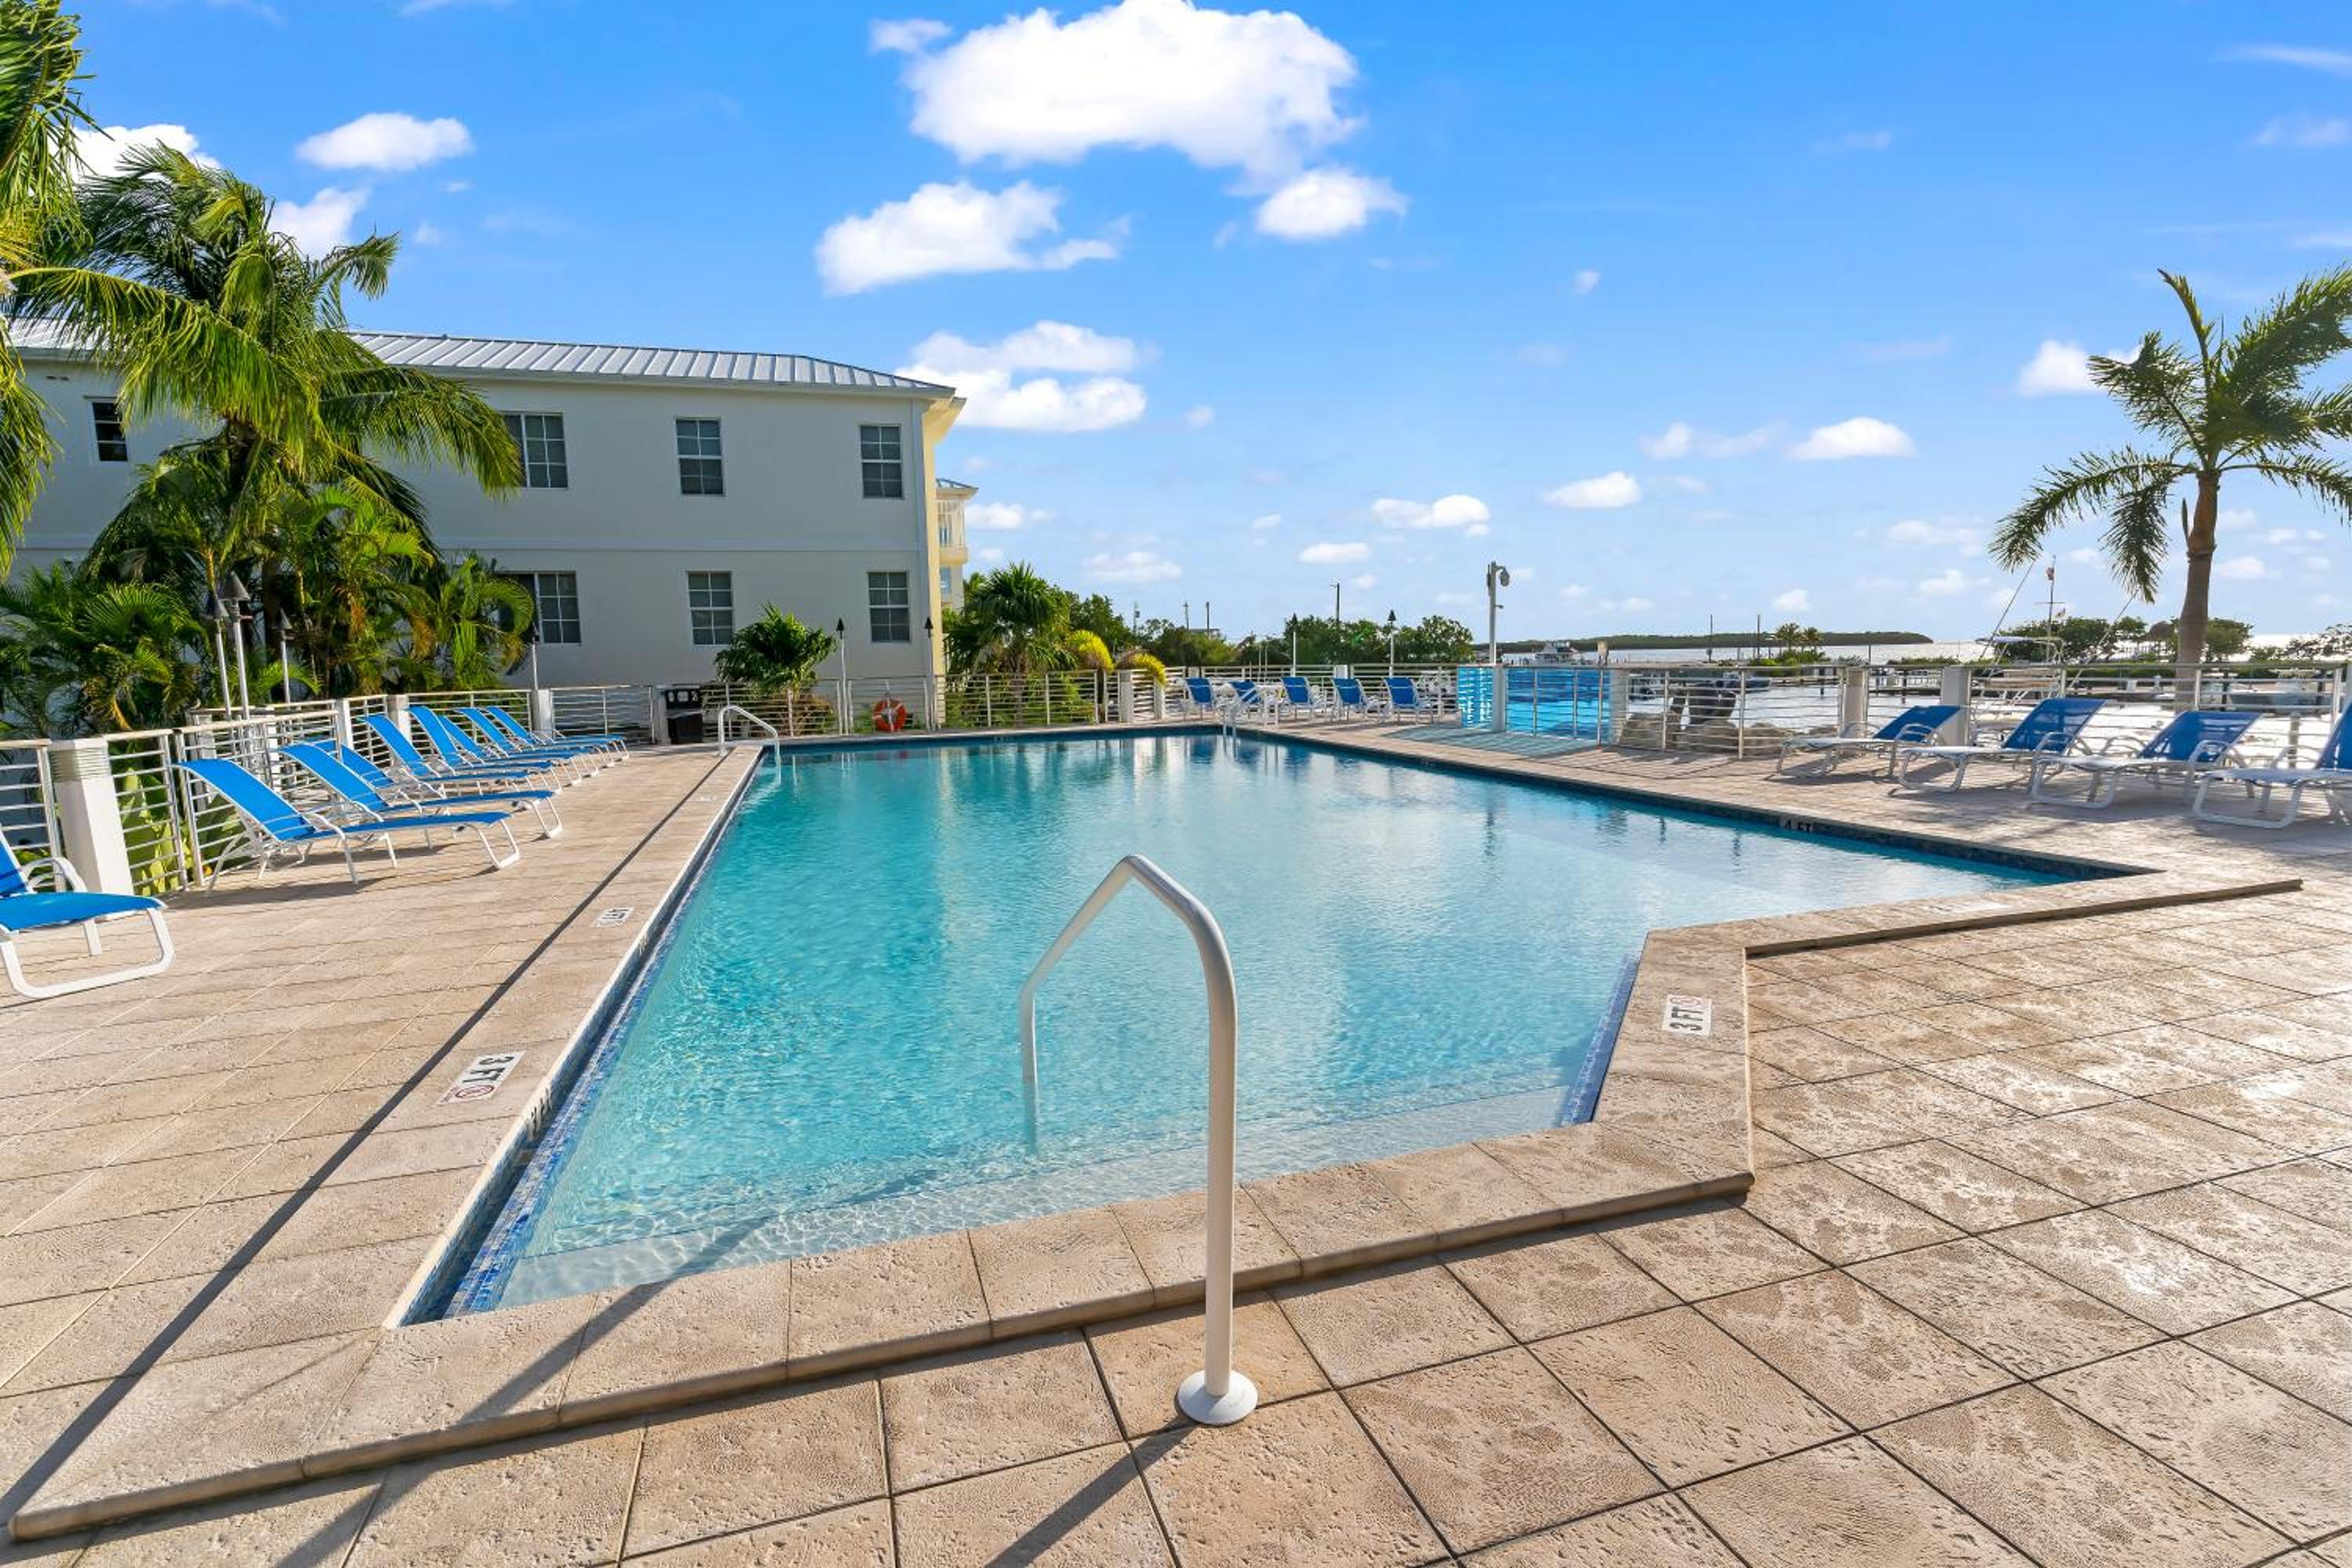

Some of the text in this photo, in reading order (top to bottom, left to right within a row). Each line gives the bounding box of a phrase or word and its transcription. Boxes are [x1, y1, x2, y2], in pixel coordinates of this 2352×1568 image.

[1669, 1006, 1704, 1031] 3 FT
[462, 1056, 514, 1083] 3 FT
